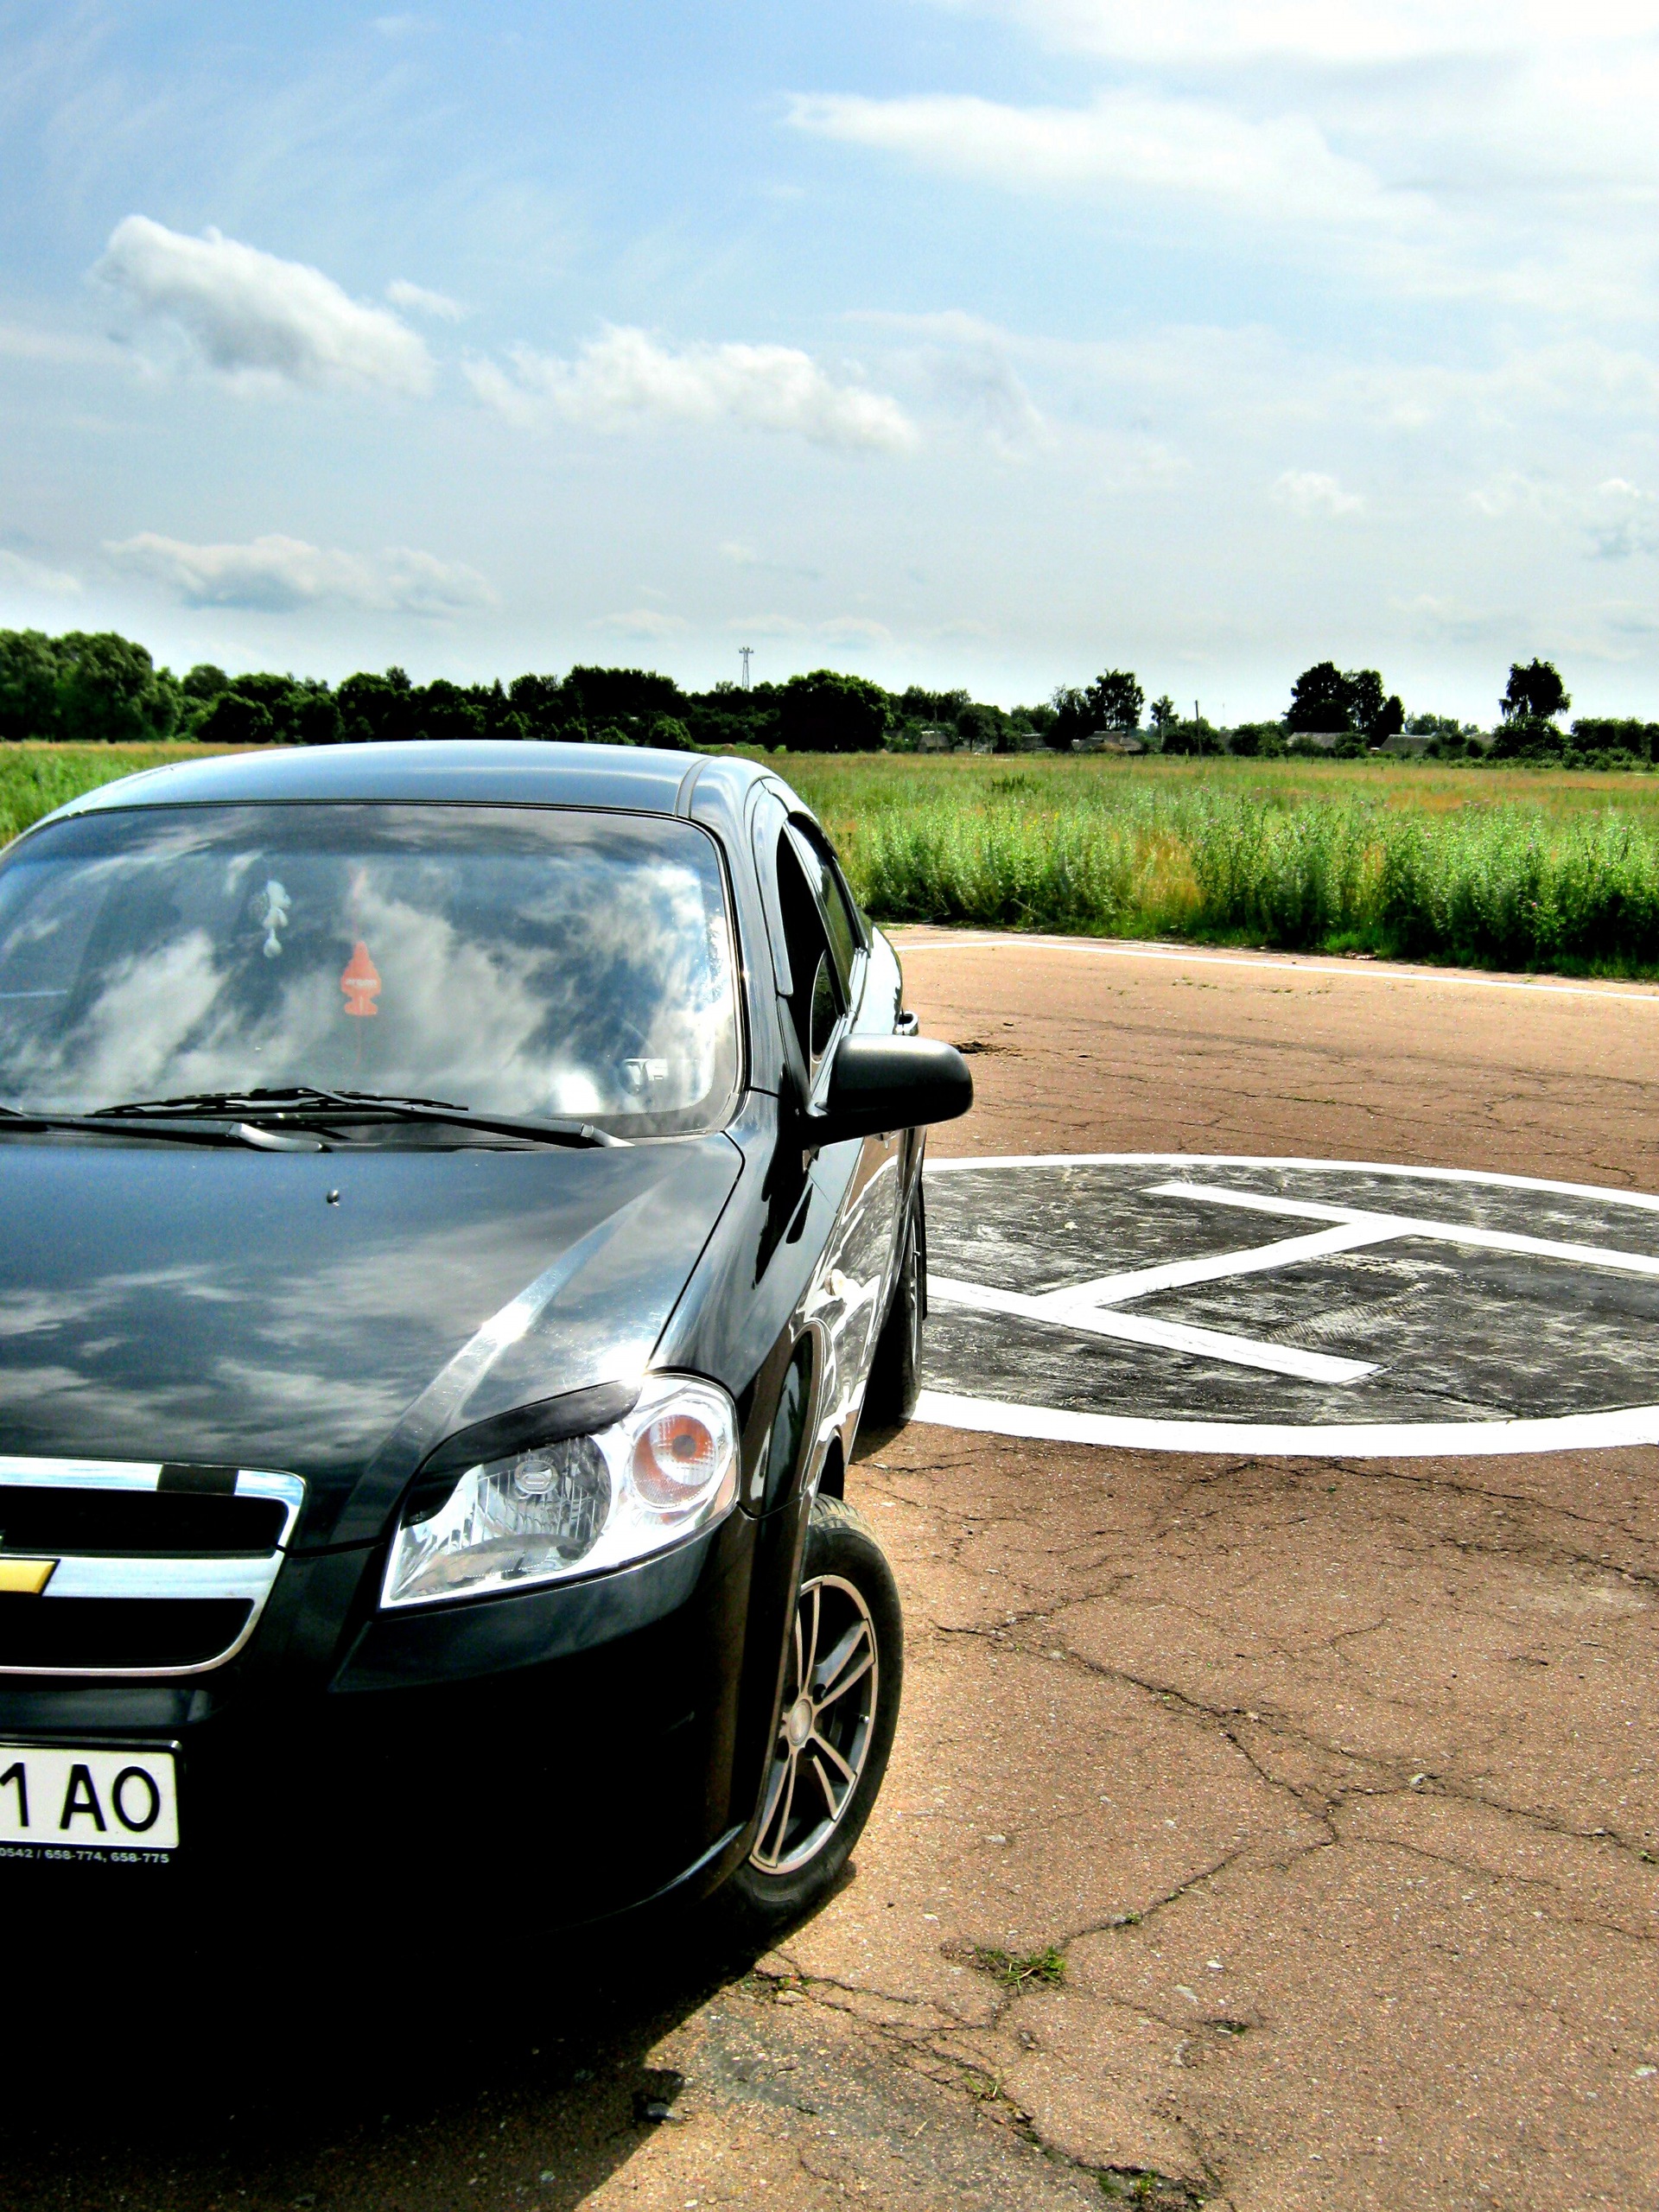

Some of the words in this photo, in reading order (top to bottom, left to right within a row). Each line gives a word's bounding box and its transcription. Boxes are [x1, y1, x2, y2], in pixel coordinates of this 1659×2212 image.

[59, 1763, 162, 1833] AO
[44, 1849, 107, 1863] 658-774,
[111, 1852, 170, 1864] 658-775
